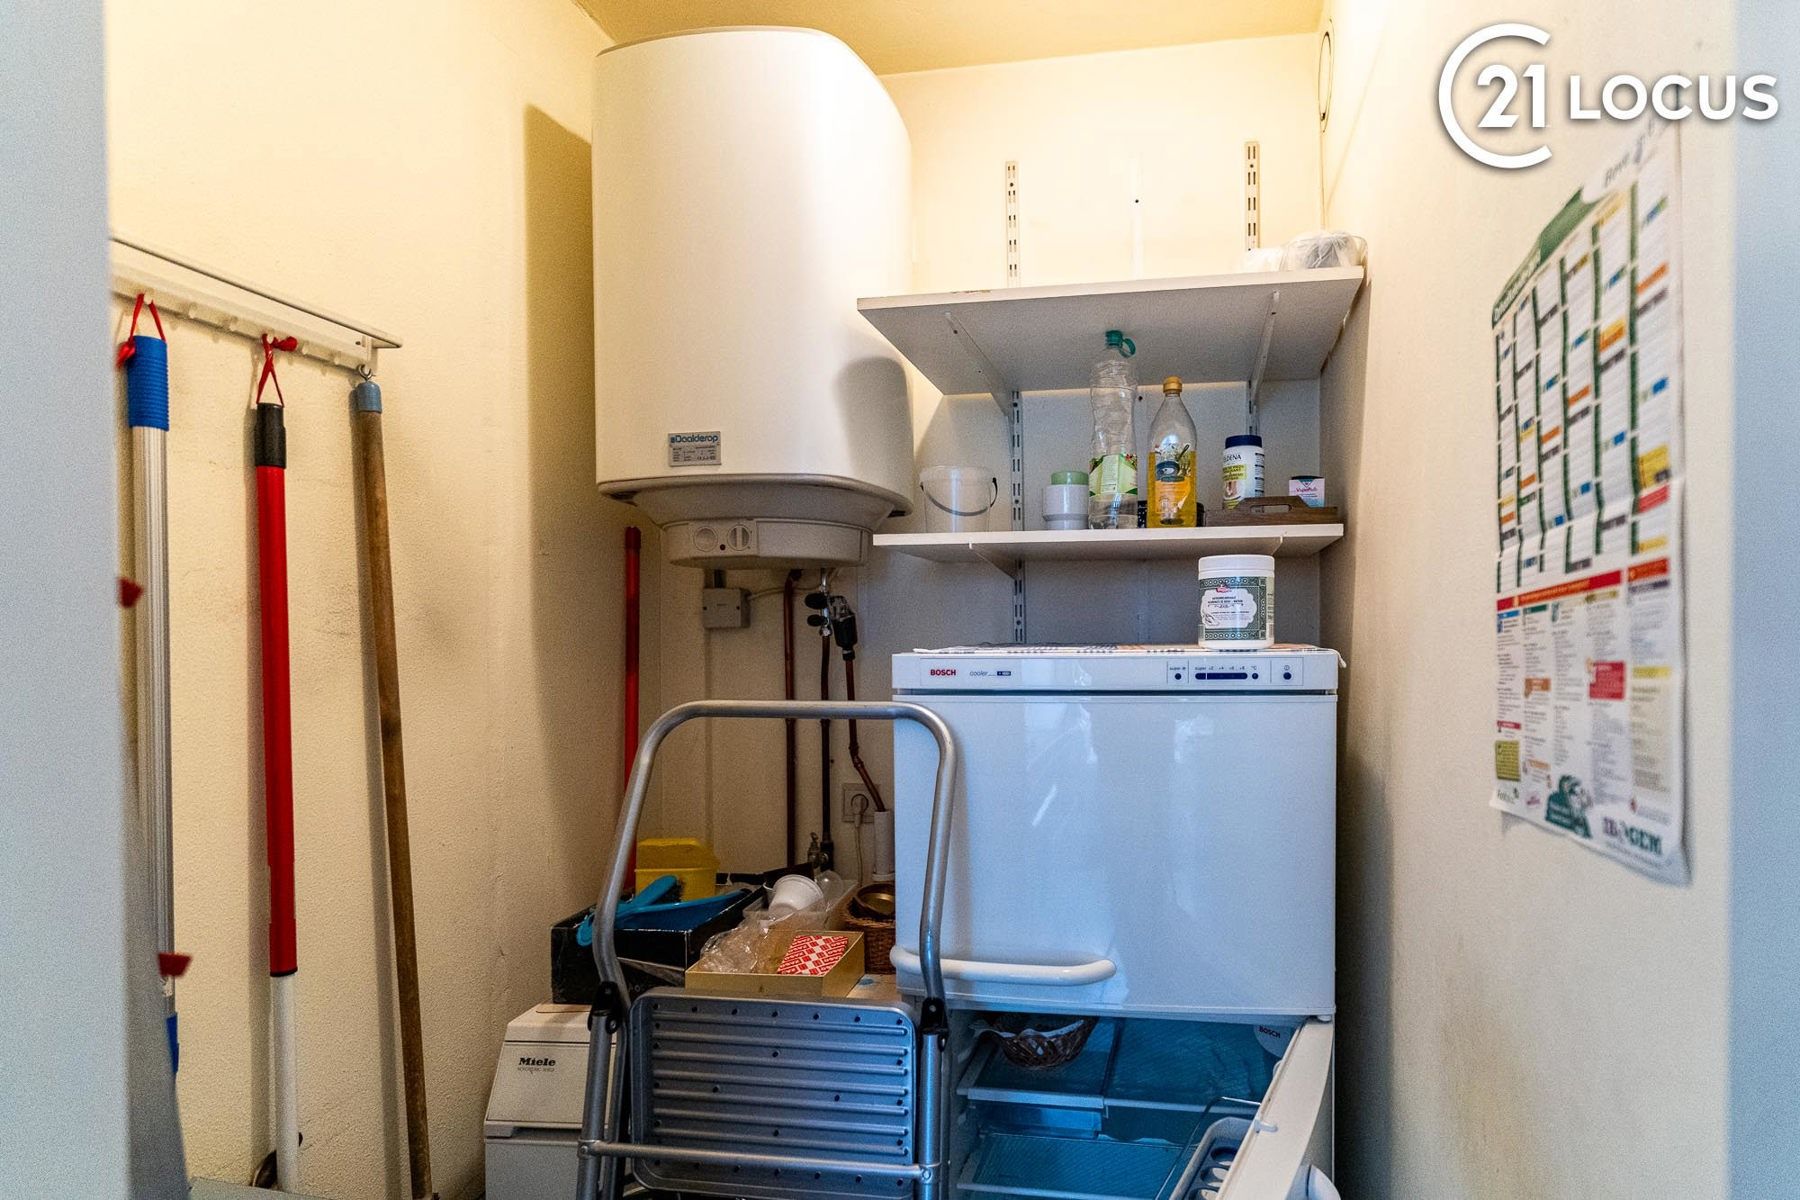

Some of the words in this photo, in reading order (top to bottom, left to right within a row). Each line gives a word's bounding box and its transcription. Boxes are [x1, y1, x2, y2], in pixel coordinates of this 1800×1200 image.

[930, 668, 957, 677] BOSCH
[1259, 1025, 1280, 1038] BOSCH
[518, 1057, 556, 1066] Miele
